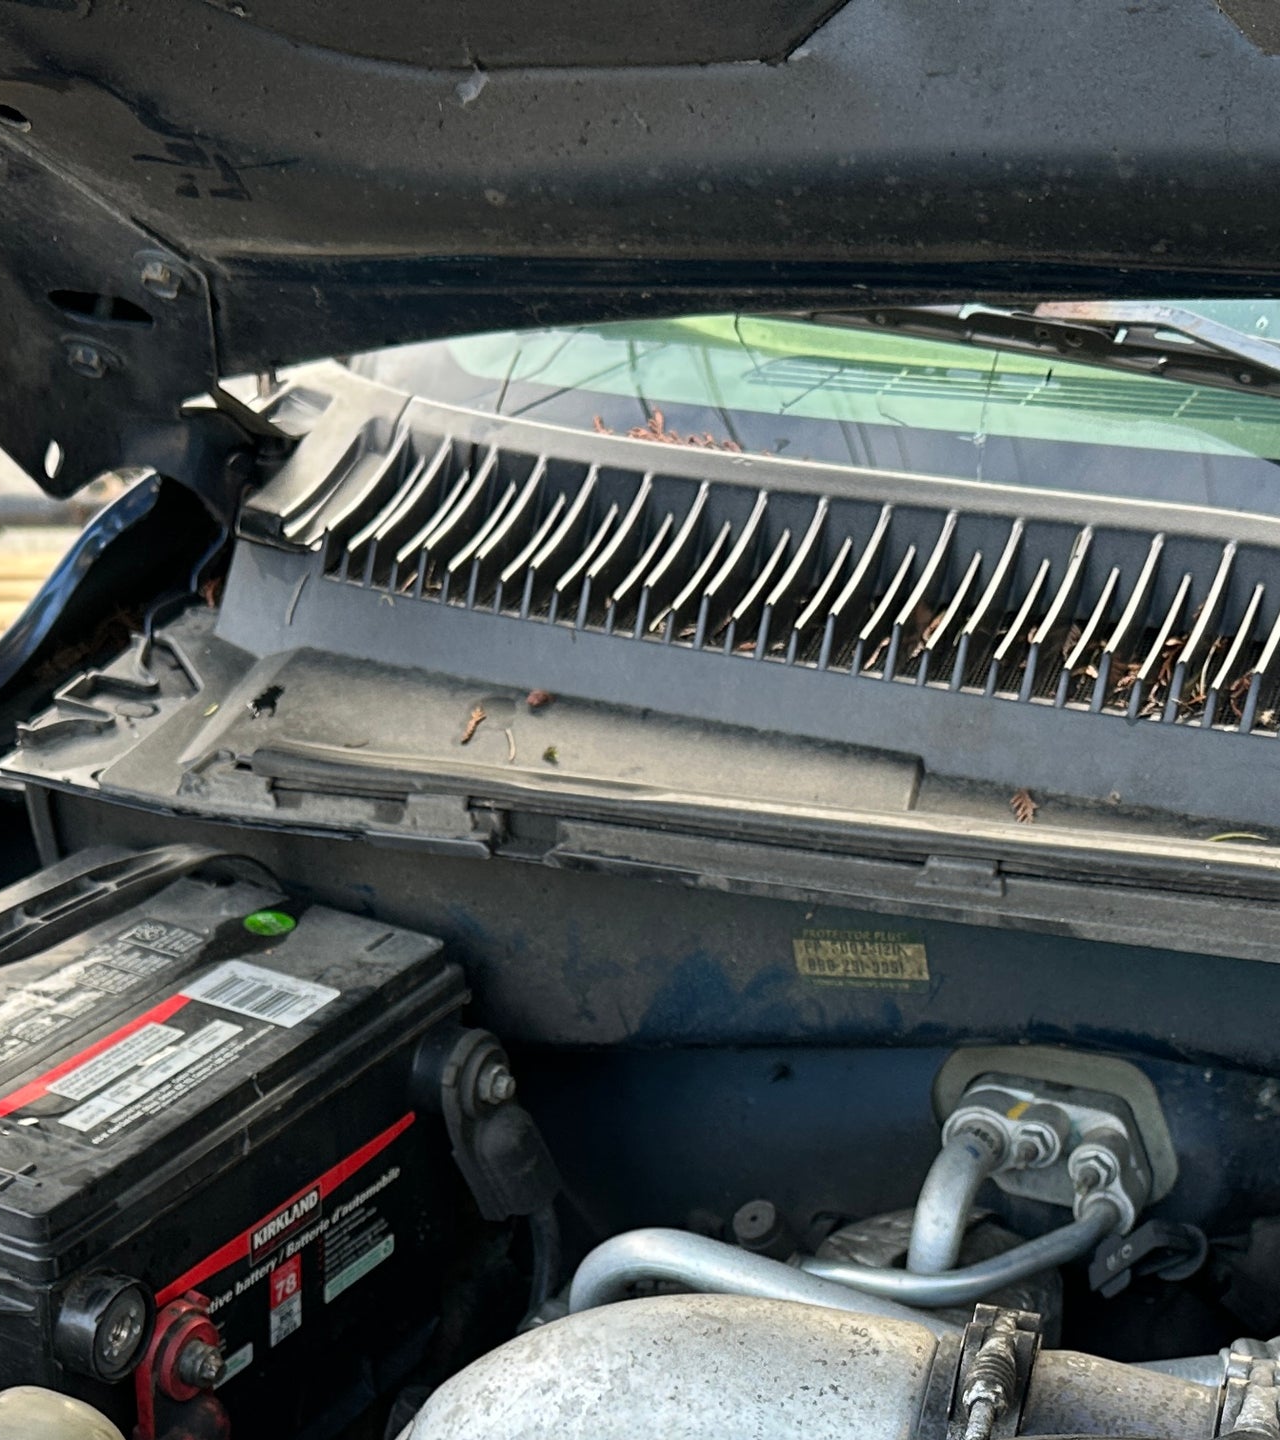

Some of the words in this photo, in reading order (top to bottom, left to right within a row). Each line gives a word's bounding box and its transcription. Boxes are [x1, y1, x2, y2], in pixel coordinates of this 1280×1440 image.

[235, 1256, 278, 1296] battery
[286, 1218, 330, 1257] Batterie
[331, 1166, 401, 1225] d'automobile
[253, 1189, 318, 1250] KIRKLAND
[275, 1272, 298, 1302] 78
